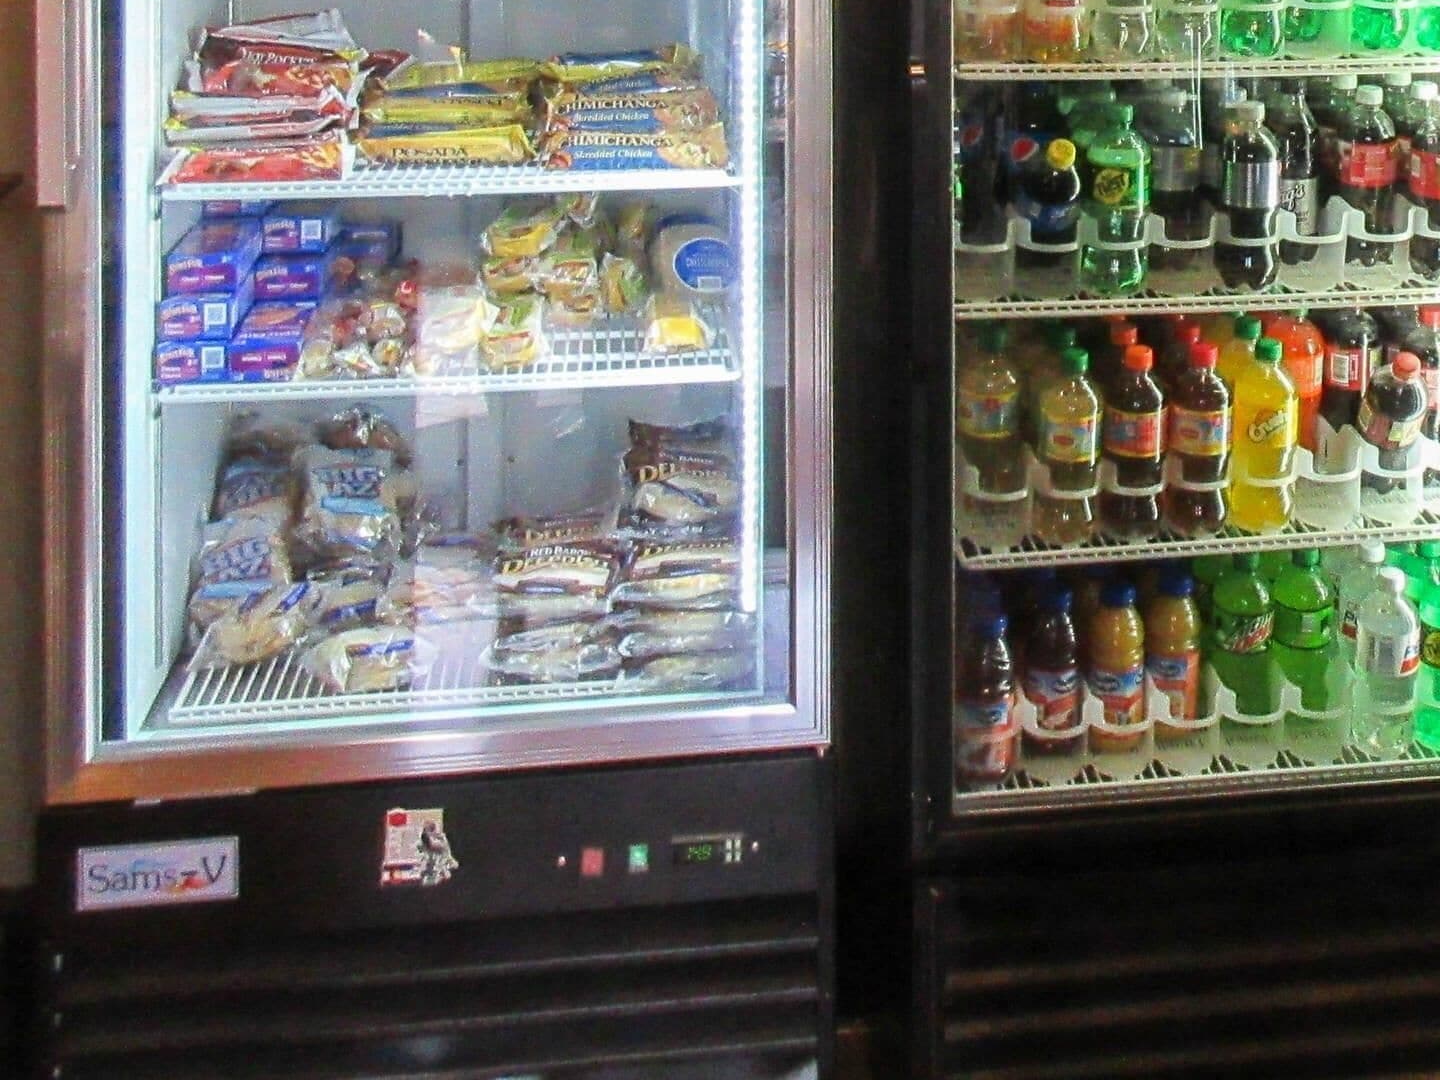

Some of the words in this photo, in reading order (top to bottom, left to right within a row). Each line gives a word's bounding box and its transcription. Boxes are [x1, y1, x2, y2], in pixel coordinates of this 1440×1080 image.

[556, 98, 669, 115] CHIMICHANGA
[615, 111, 650, 121] Chicken
[617, 148, 653, 159] Chicken
